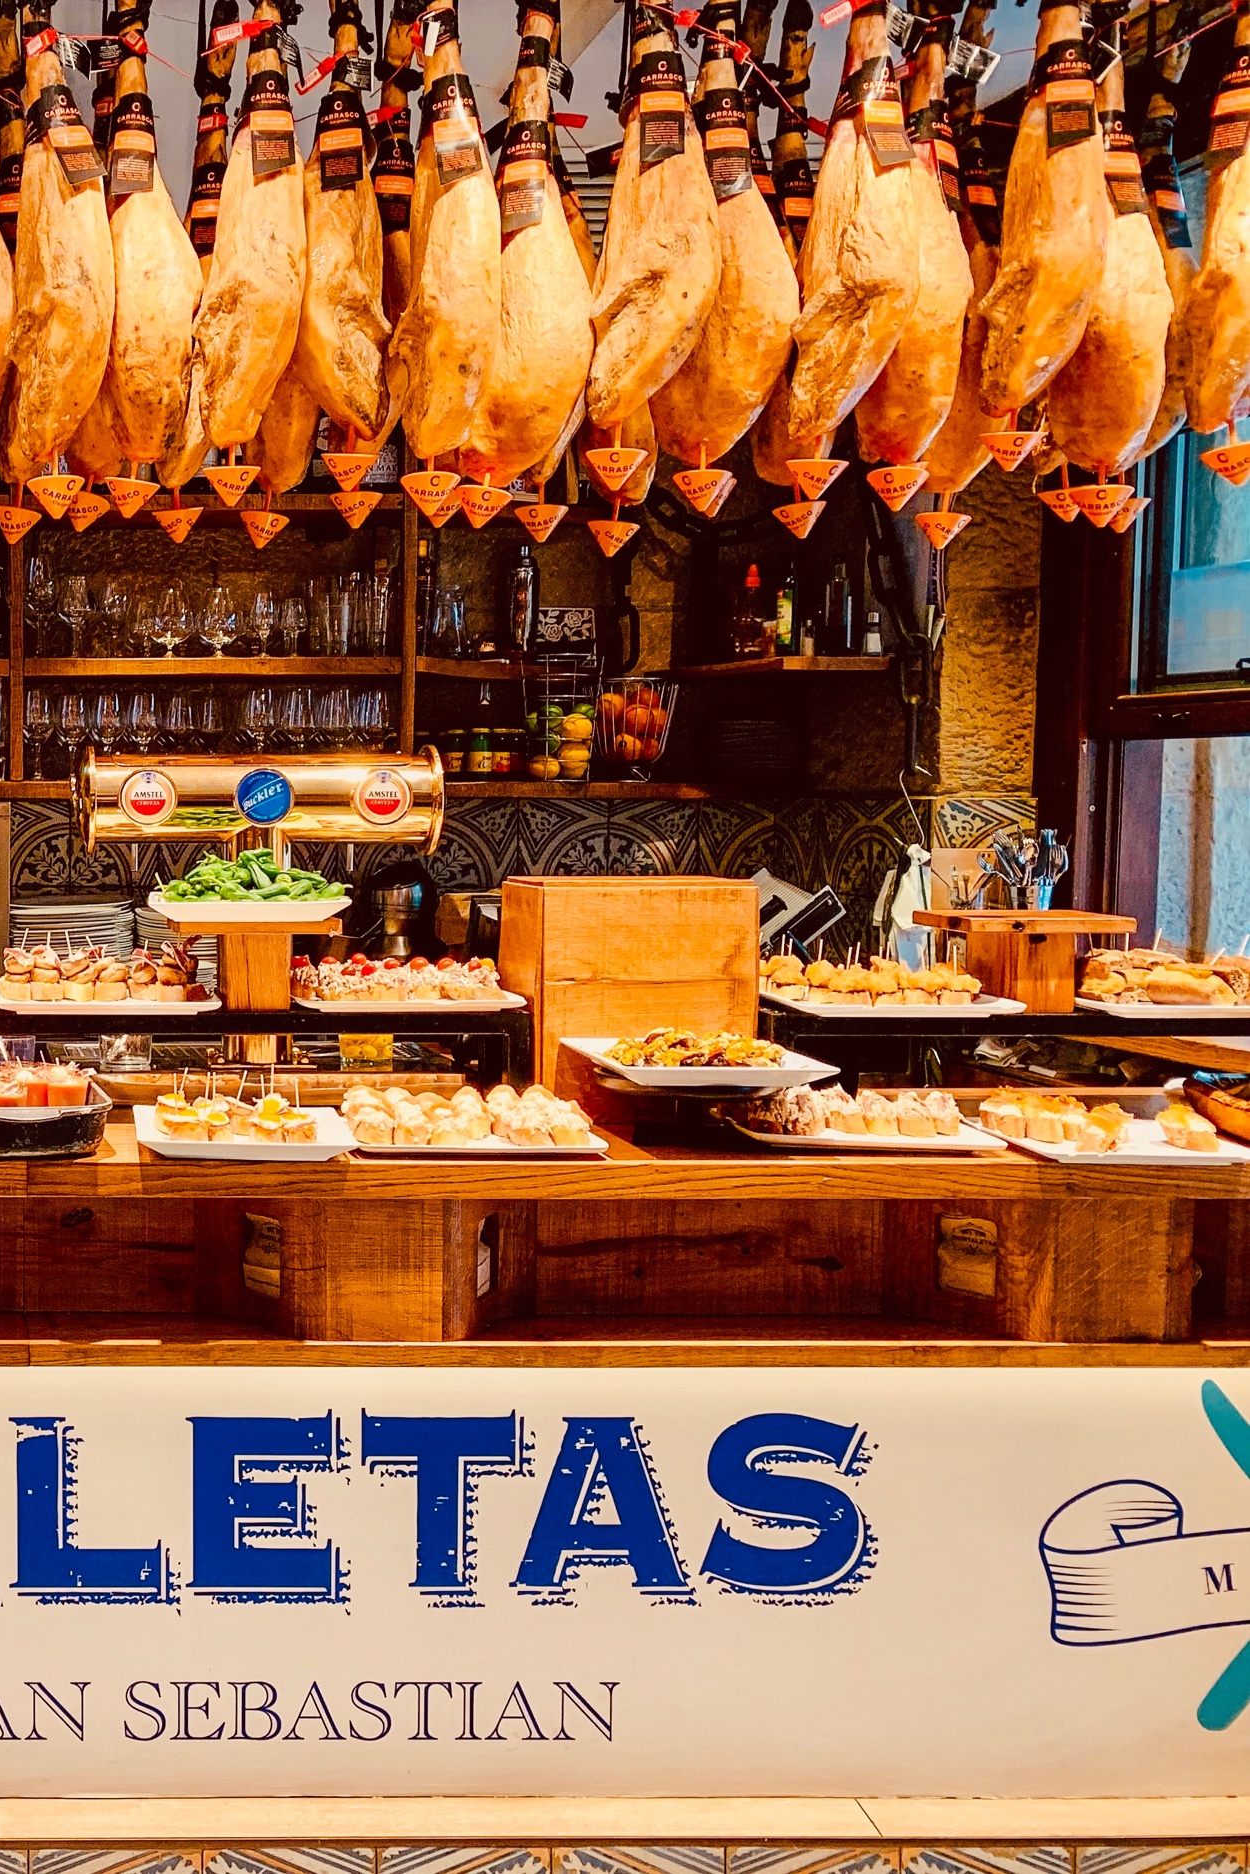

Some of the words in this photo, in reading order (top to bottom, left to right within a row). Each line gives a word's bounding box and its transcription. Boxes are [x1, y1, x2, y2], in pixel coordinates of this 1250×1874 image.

[1047, 62, 1092, 73] CARRASCO
[641, 73, 683, 83] CARRASCO
[250, 92, 289, 102] CARRASCO
[44, 107, 82, 118] CARRASCO
[320, 111, 360, 123] CARRASCO
[705, 110, 746, 120] CARRASCO
[117, 114, 153, 125] CARRASCO
[507, 142, 547, 155] CARRASCO
[124, 1681, 621, 1743] SEBASTIAN
